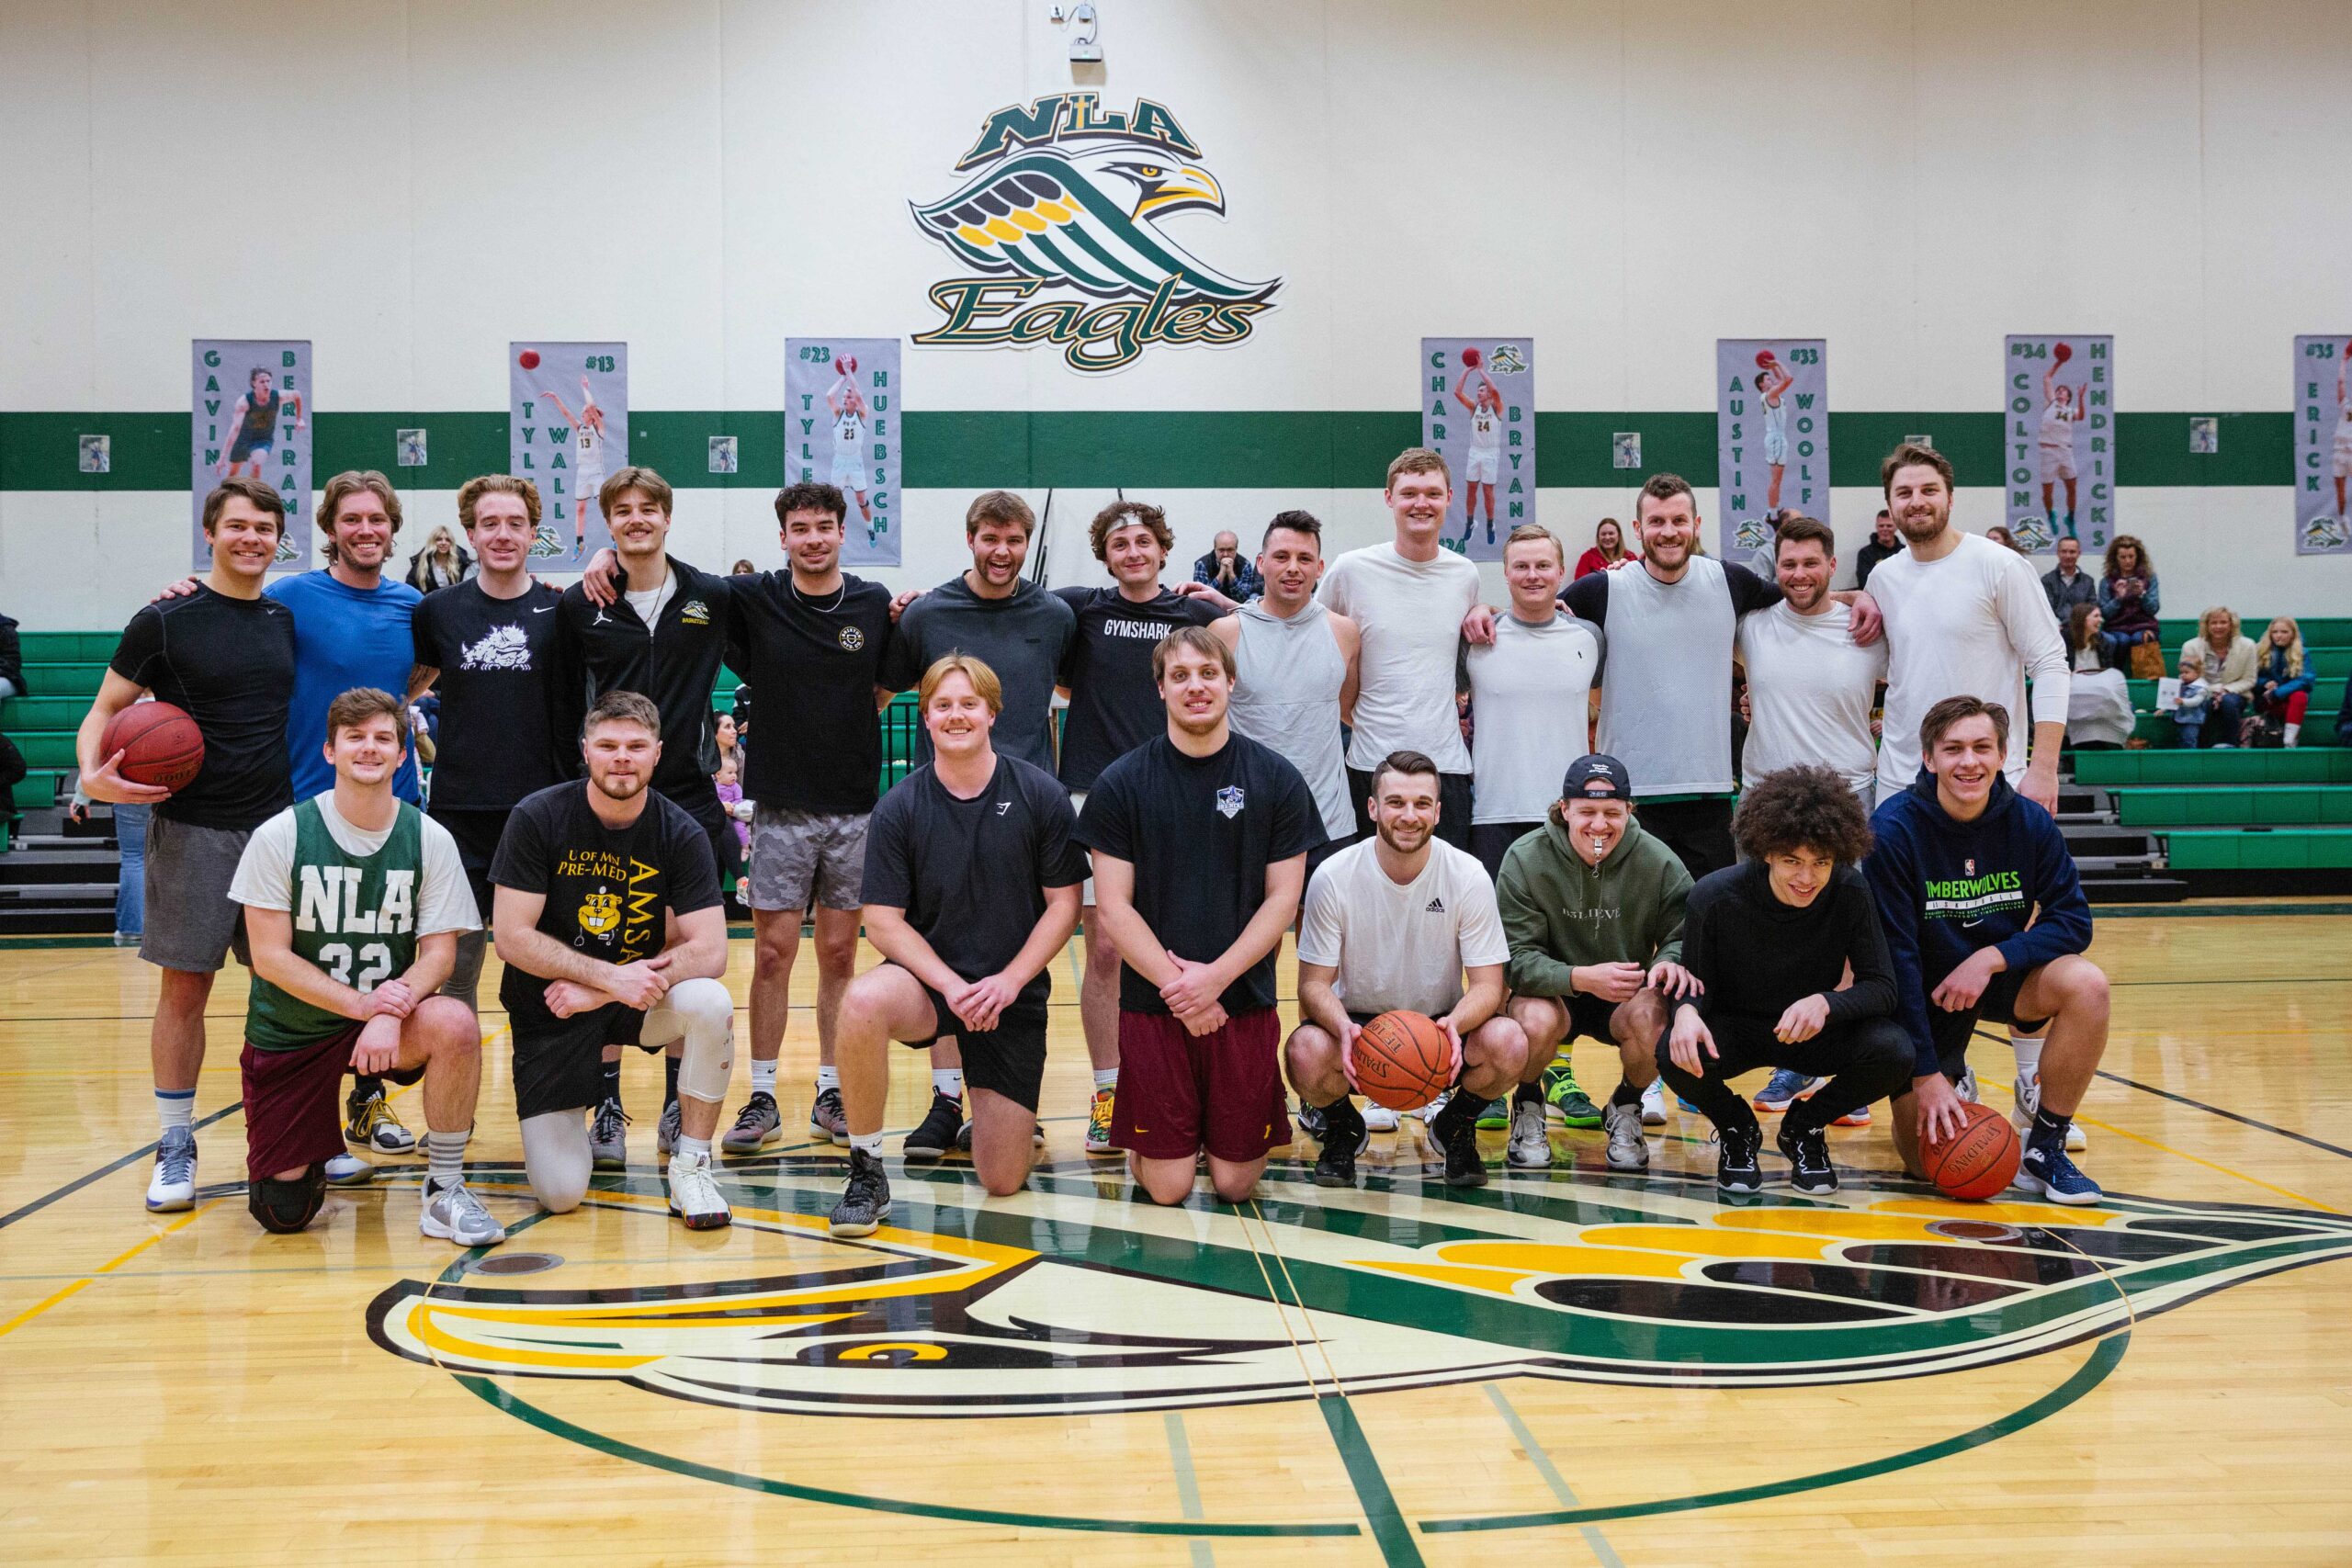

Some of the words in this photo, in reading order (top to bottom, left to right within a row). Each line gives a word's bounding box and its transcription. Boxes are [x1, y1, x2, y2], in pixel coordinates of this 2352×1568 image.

[955, 92, 1203, 171] NLA
[800, 346, 831, 363] #23
[911, 272, 1265, 371] Eagles
[1790, 348, 1818, 365] #33
[2011, 343, 2047, 359] #34
[586, 355, 615, 373] #13
[204, 350, 221, 466] GAVIN
[281, 351, 298, 515] BERTRAM
[522, 401, 535, 482] TYL
[580, 438, 591, 449] 13
[1477, 421, 1489, 432] 24
[1729, 376, 1746, 511] AUSTIN
[2012, 373, 2031, 507] COLTON
[2090, 343, 2107, 547] HENDRICKS
[2306, 382, 2320, 491] ERICK
[548, 427, 570, 519] WALL
[874, 371, 888, 533] HUEBSCH
[1509, 406, 1523, 531] BRYAN
[1795, 393, 1815, 504] WOOLF
[1104, 619, 1171, 640] GYMSHARK
[557, 861, 627, 882] PRE-MED
[569, 850, 578, 862] U
[580, 851, 597, 862] OF
[600, 852, 620, 866] MN
[296, 865, 415, 934] NLA
[616, 855, 660, 966] AMSA
[319, 942, 392, 993] 32
[1352, 1045, 1390, 1078] SPALD
[1948, 1122, 2001, 1177] SPALDING
